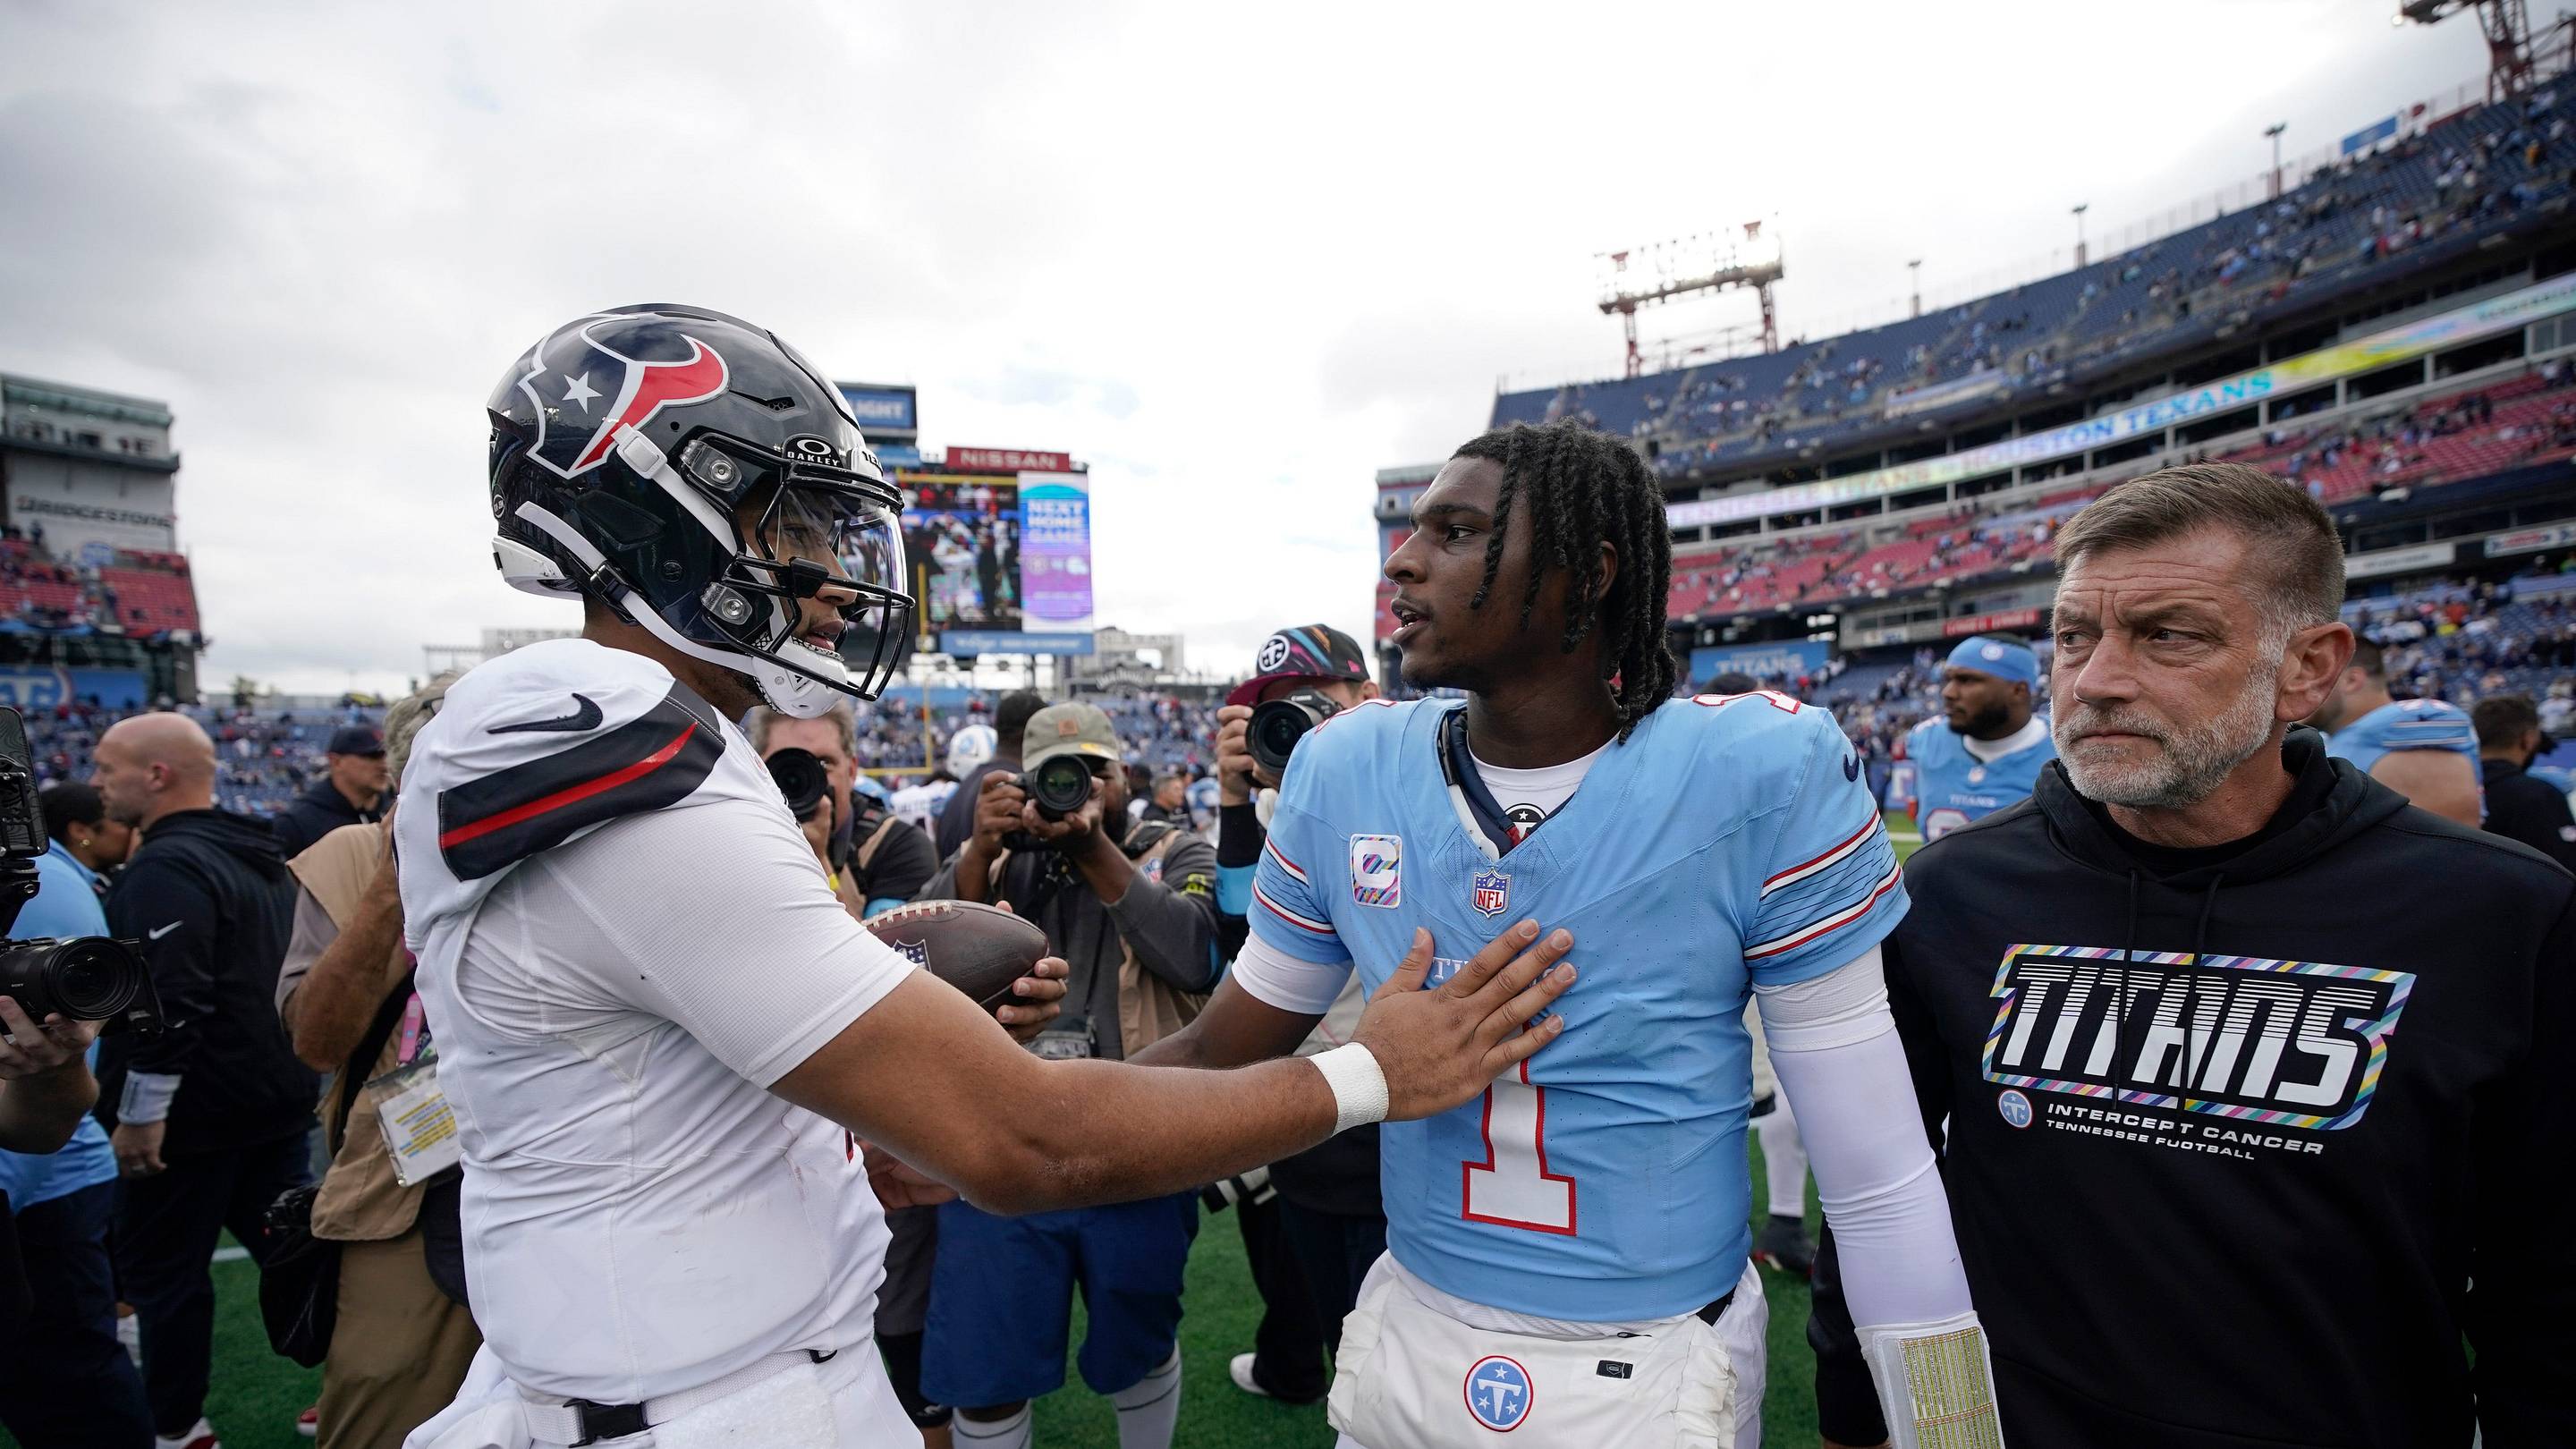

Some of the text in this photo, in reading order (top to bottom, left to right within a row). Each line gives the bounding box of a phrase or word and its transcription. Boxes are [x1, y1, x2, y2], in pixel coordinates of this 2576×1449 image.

[2126, 370, 2274, 433] TEXANS
[787, 451, 839, 466] OAKLEY
[960, 449, 1057, 470] NISSAN
[1028, 500, 1083, 514] NEXT
[1716, 653, 1804, 677] TITANS
[1950, 793, 1996, 808] TITANS
[1353, 839, 1399, 888] C
[1477, 889, 1503, 911] NFL
[2001, 962, 2377, 1107] TITANS
[1462, 1038, 1577, 1237] 1
[2046, 1119, 2255, 1160] TENNESSEE FOOTBALL
[2047, 1103, 2324, 1156] INTERCEPT CANCER
